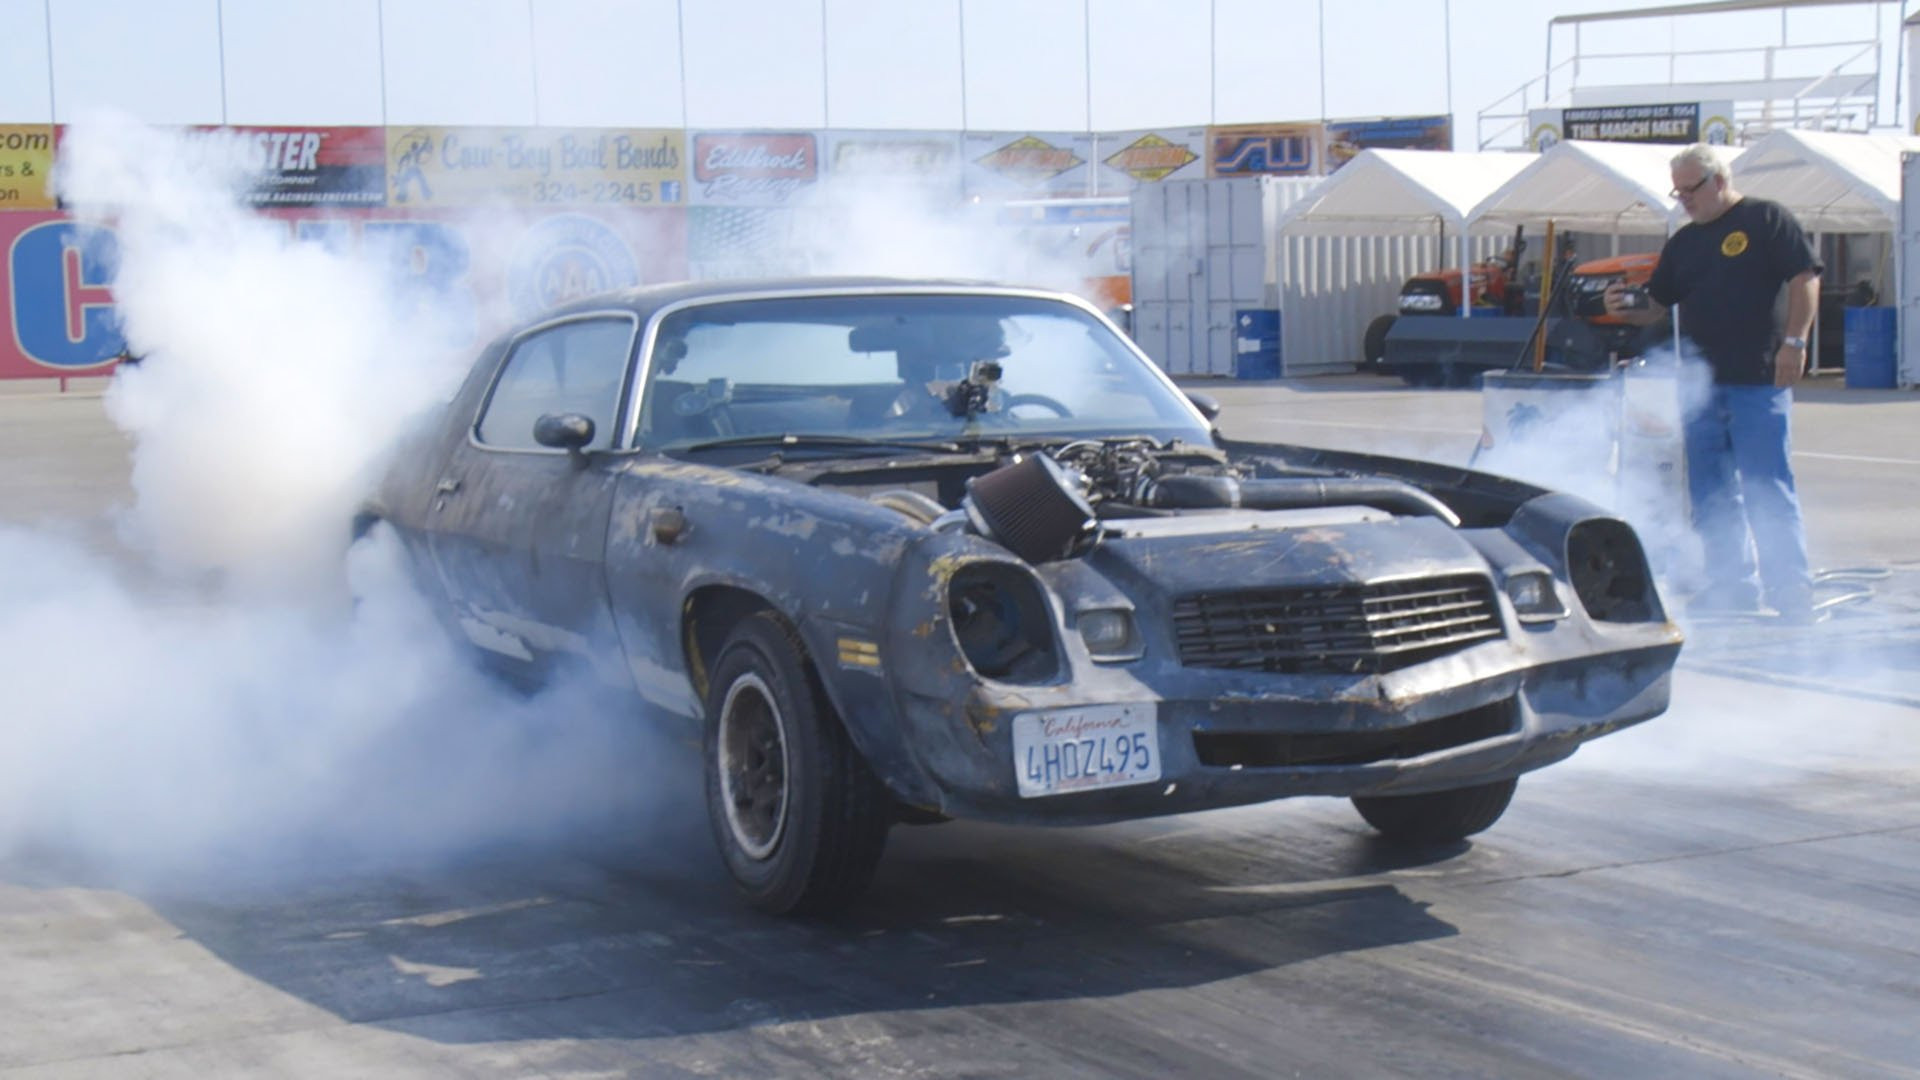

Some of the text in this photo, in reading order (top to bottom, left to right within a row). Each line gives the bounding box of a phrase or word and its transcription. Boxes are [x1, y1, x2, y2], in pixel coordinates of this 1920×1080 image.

[1571, 119, 1690, 139] THE MARCH MEET
[613, 136, 679, 171] Bonds
[21, 161, 34, 177] &
[533, 180, 654, 202] 324-2245
[1044, 715, 1129, 738] California
